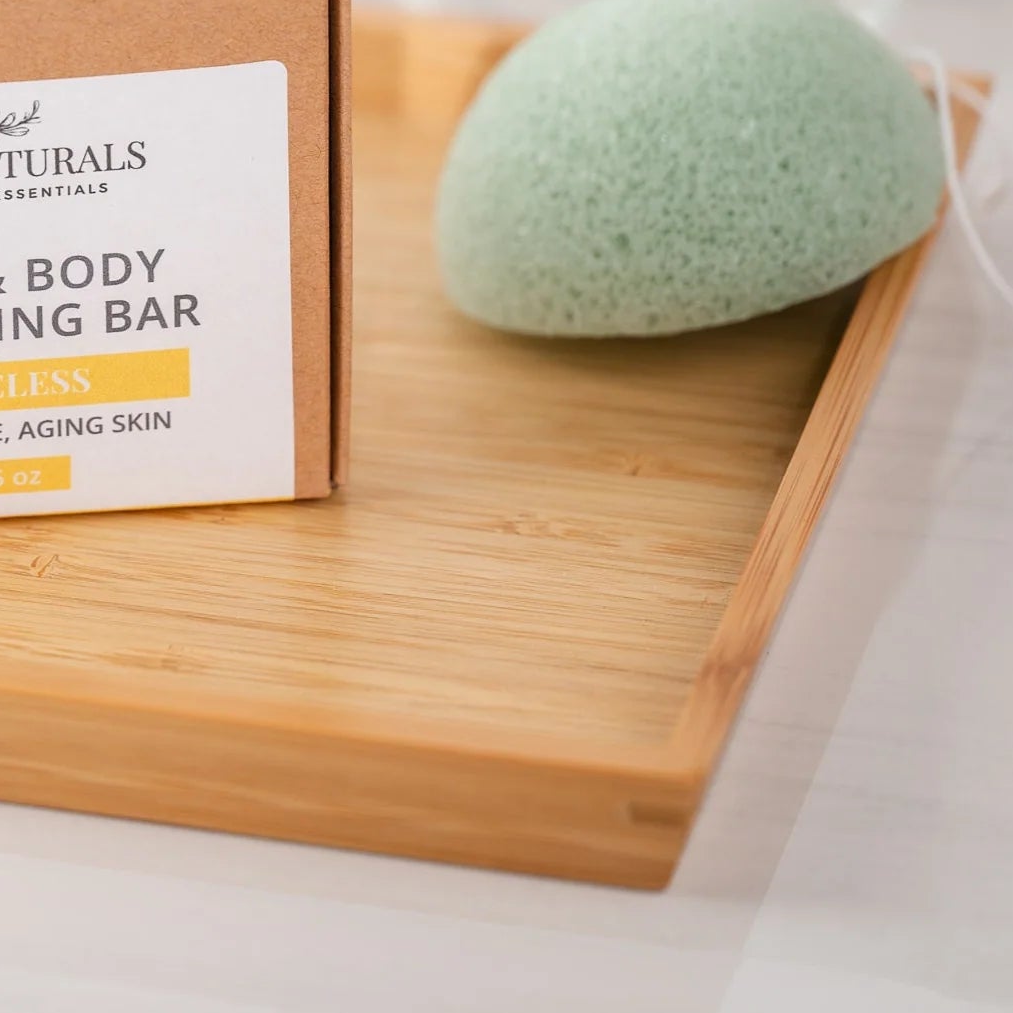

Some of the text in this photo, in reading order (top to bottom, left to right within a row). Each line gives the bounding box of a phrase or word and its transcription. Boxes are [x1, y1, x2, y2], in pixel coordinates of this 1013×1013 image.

[26, 248, 166, 292] BODY
[105, 293, 201, 334] BAR
[18, 416, 104, 440] AGING
[112, 410, 172, 433] SKIN
[12, 470, 42, 486] oz
